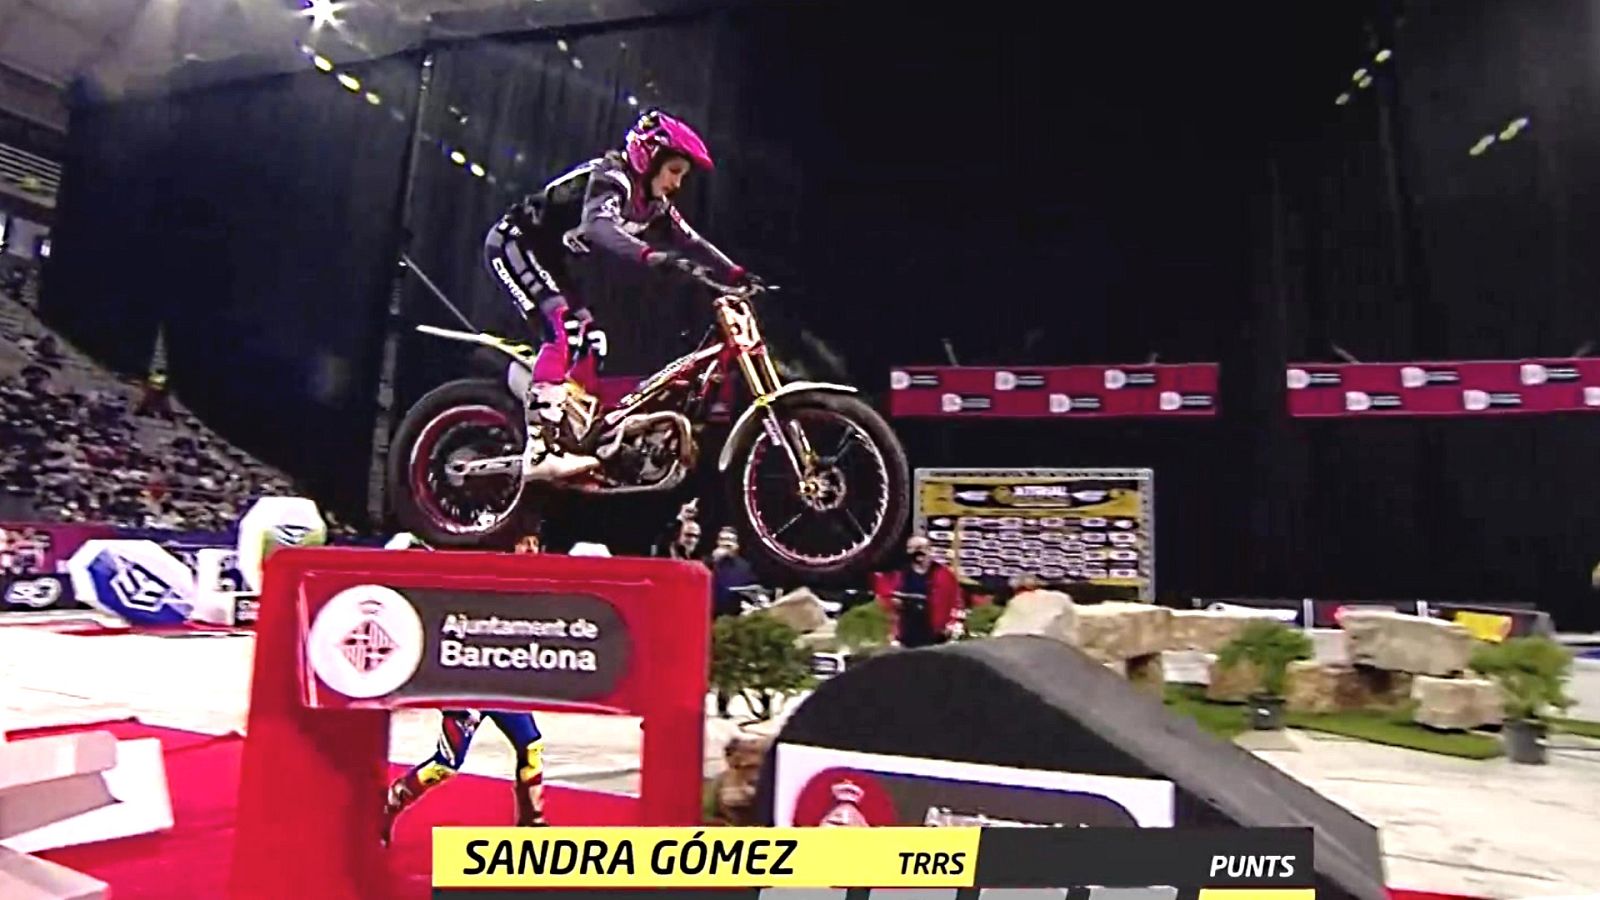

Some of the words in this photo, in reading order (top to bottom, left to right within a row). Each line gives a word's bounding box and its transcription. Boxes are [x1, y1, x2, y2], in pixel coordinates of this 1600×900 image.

[442, 614, 567, 639] Ajuntament
[569, 618, 598, 638] de
[440, 640, 597, 671] Barcelona
